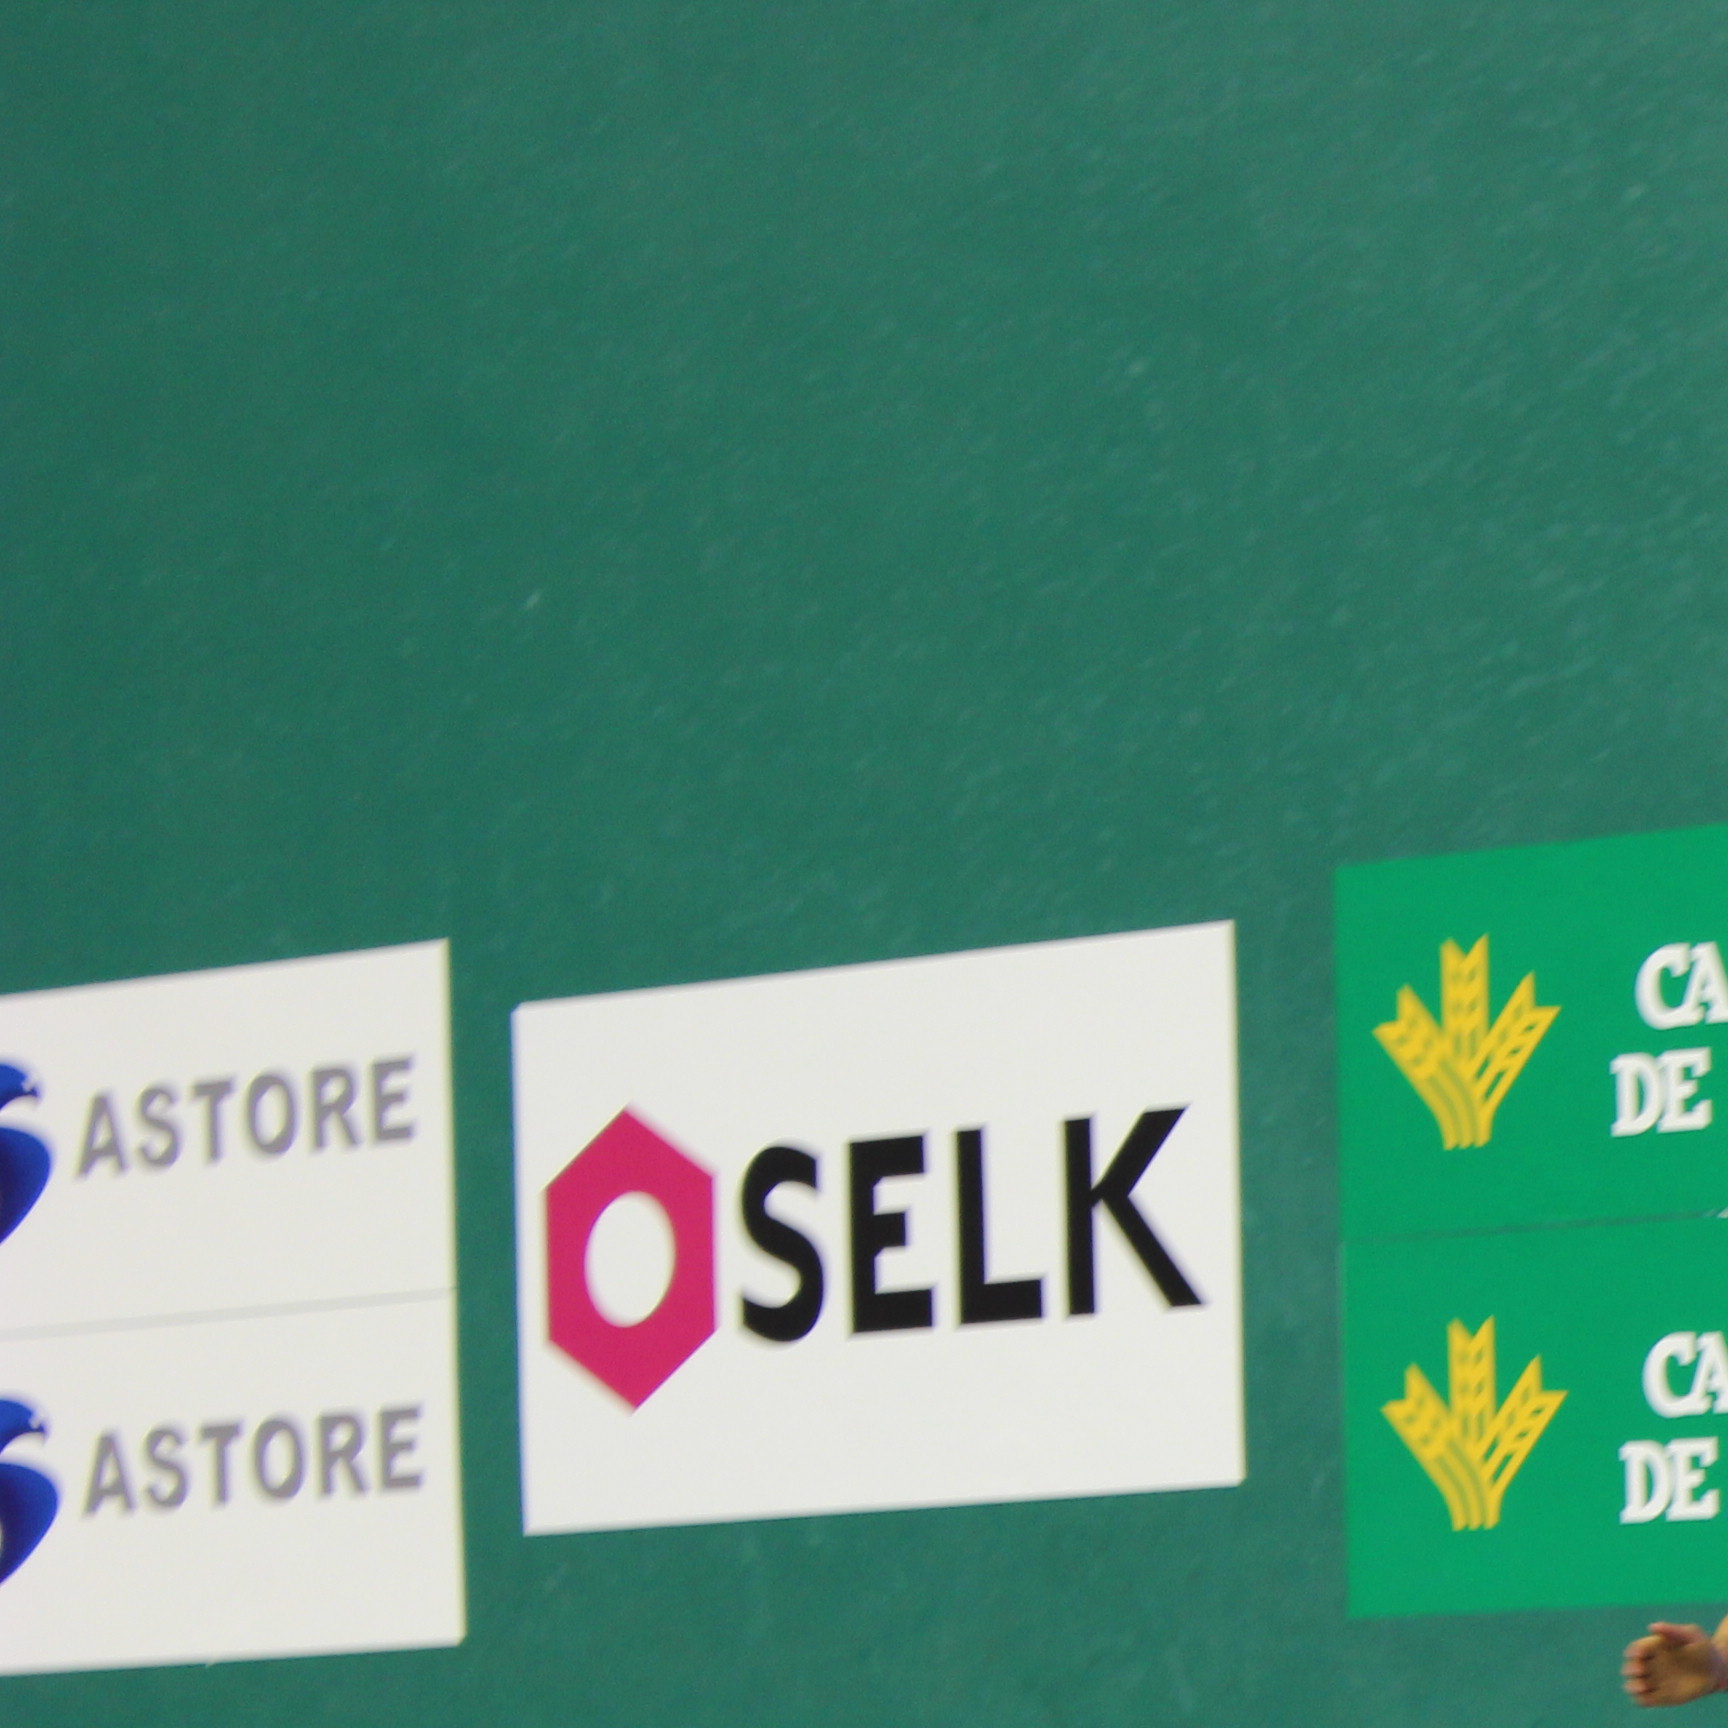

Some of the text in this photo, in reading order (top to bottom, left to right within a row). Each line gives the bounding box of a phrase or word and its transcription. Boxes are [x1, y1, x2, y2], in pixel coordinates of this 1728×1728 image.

[75, 1054, 415, 1178] ASTORE
[1610, 1046, 1713, 1138] DE
[739, 1105, 1206, 1345] SELK
[82, 1403, 423, 1517] ASTORE
[1618, 1435, 1721, 1524] DE
